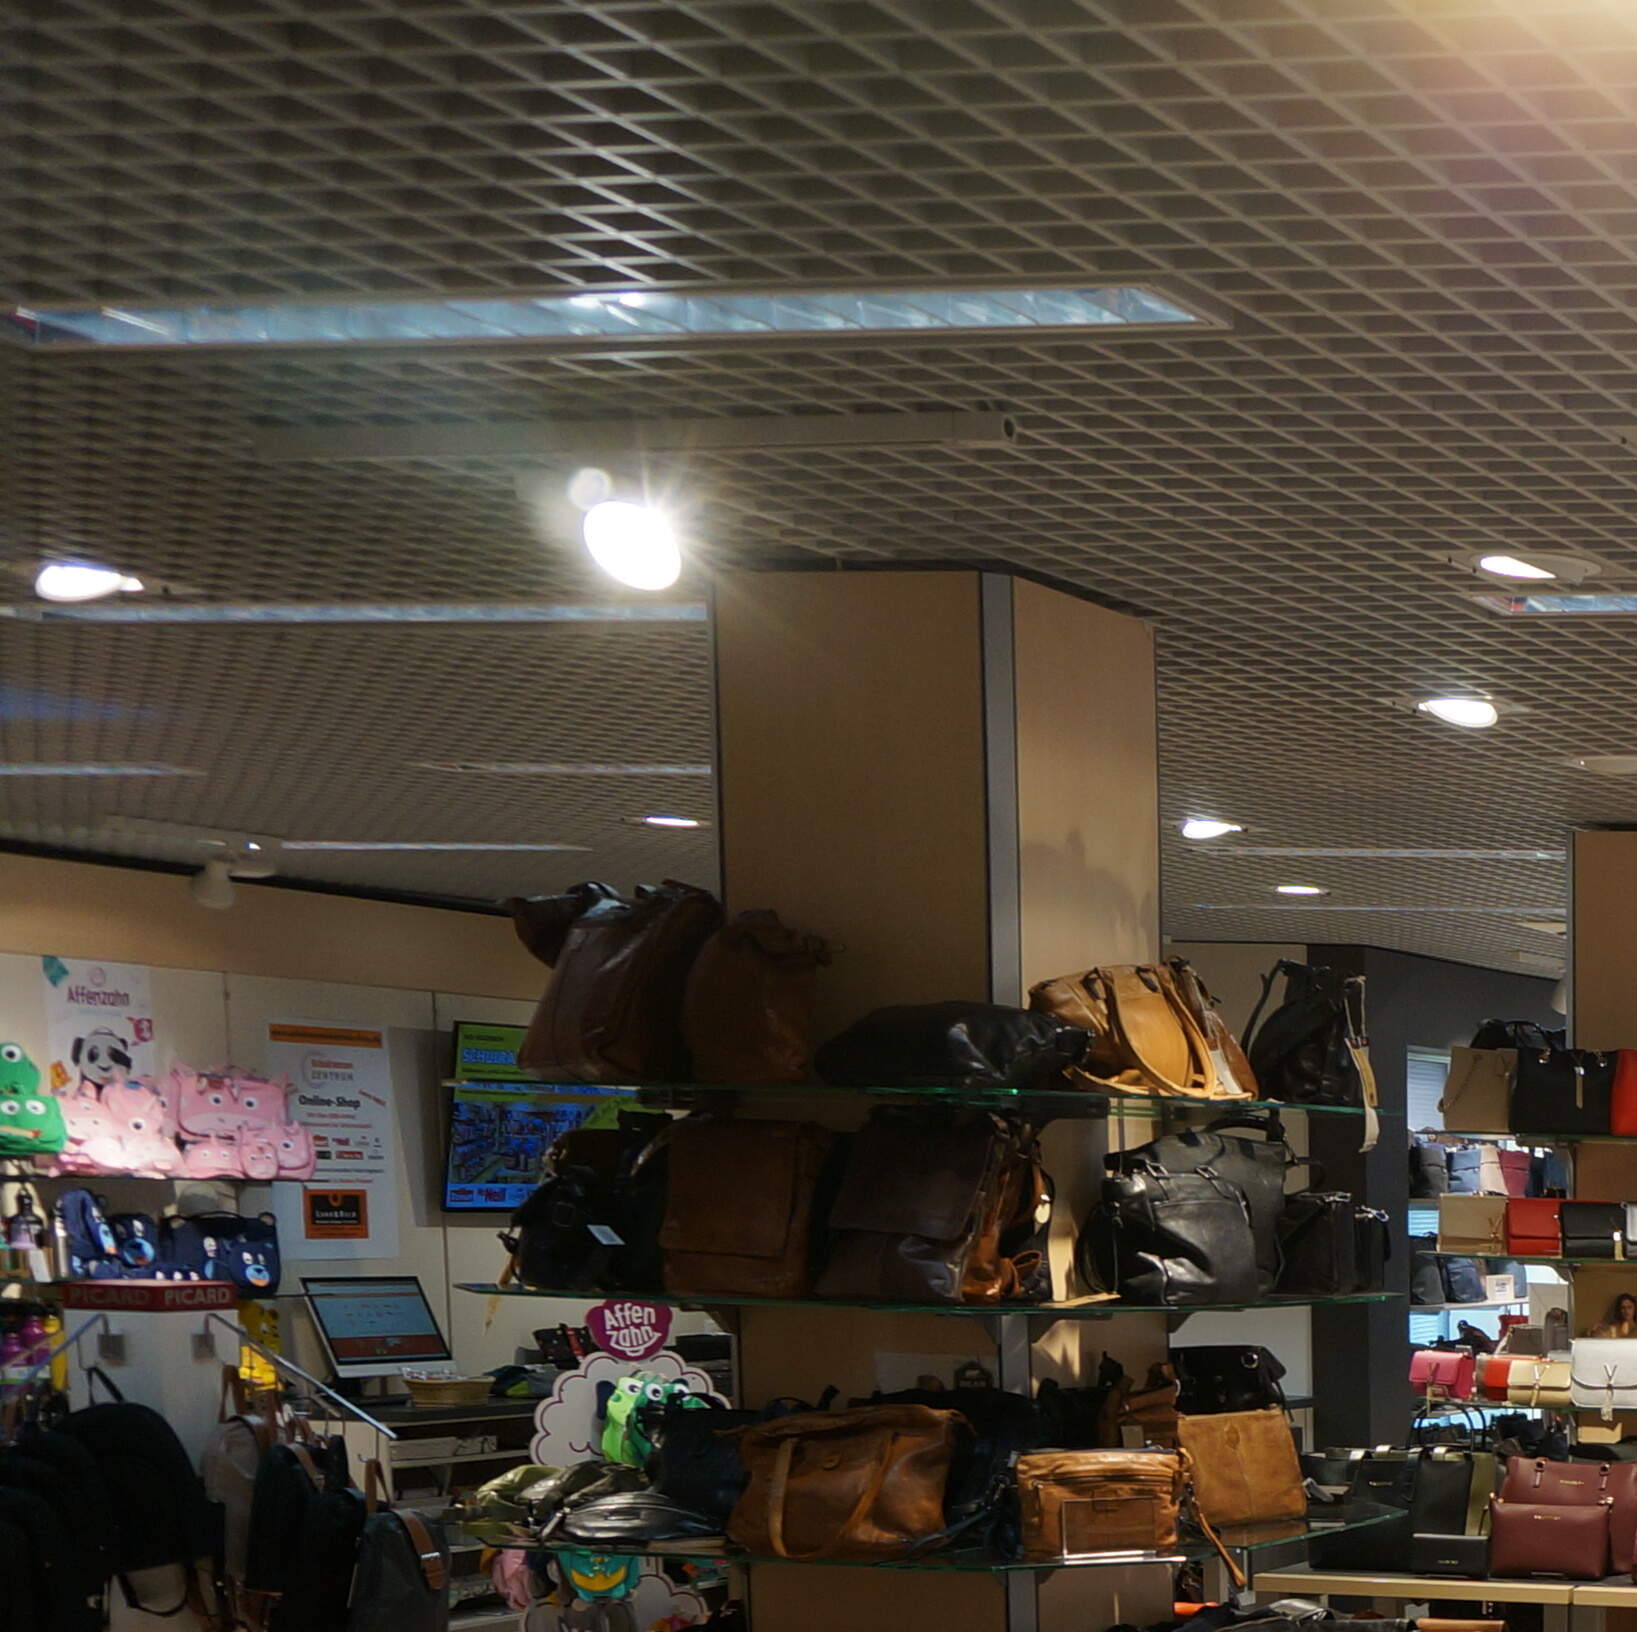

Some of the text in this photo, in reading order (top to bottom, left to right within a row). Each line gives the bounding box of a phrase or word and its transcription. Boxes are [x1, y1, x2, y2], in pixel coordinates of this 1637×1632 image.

[69, 1286, 151, 1306] PICARD
[164, 1287, 230, 1306] PICARD
[603, 1302, 656, 1330] Affen
[606, 1325, 662, 1351] zahn
